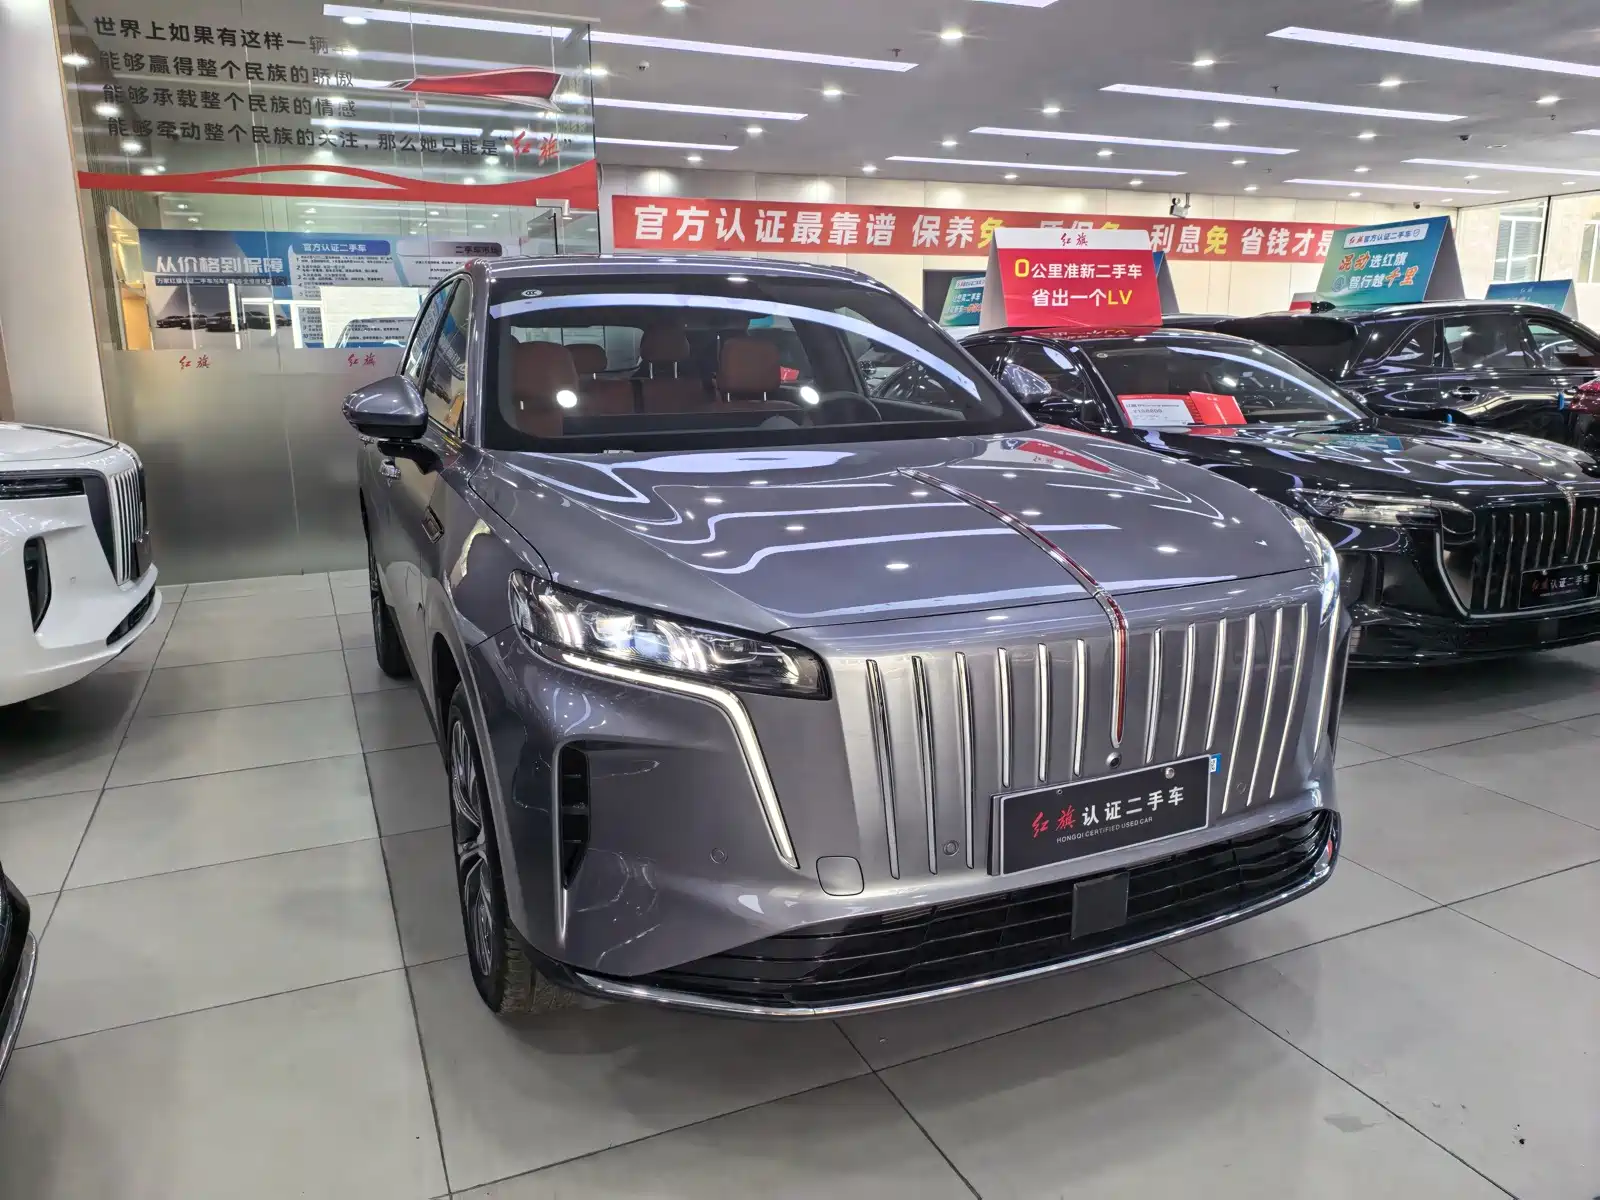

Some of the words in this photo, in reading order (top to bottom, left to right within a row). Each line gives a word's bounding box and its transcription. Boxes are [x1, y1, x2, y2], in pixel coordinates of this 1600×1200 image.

[100, 51, 353, 87] 能够赢得整个民族的骄傲
[103, 84, 357, 117] 能够承载整个民族的情感
[634, 204, 896, 245] 官方认证最靠谱
[1150, 224, 1229, 255] 利息免
[302, 243, 367, 252] 官方认证二手车
[156, 255, 284, 274] 从价格到保障
[1015, 259, 1143, 279] 0公里准新二手车
[1032, 288, 1133, 307] 省出一个LV
[1056, 832, 1085, 844] HONGQI
[1084, 824, 1121, 838] CERTIFIED
[1121, 819, 1139, 830] USED
[1139, 816, 1153, 825] CAR
